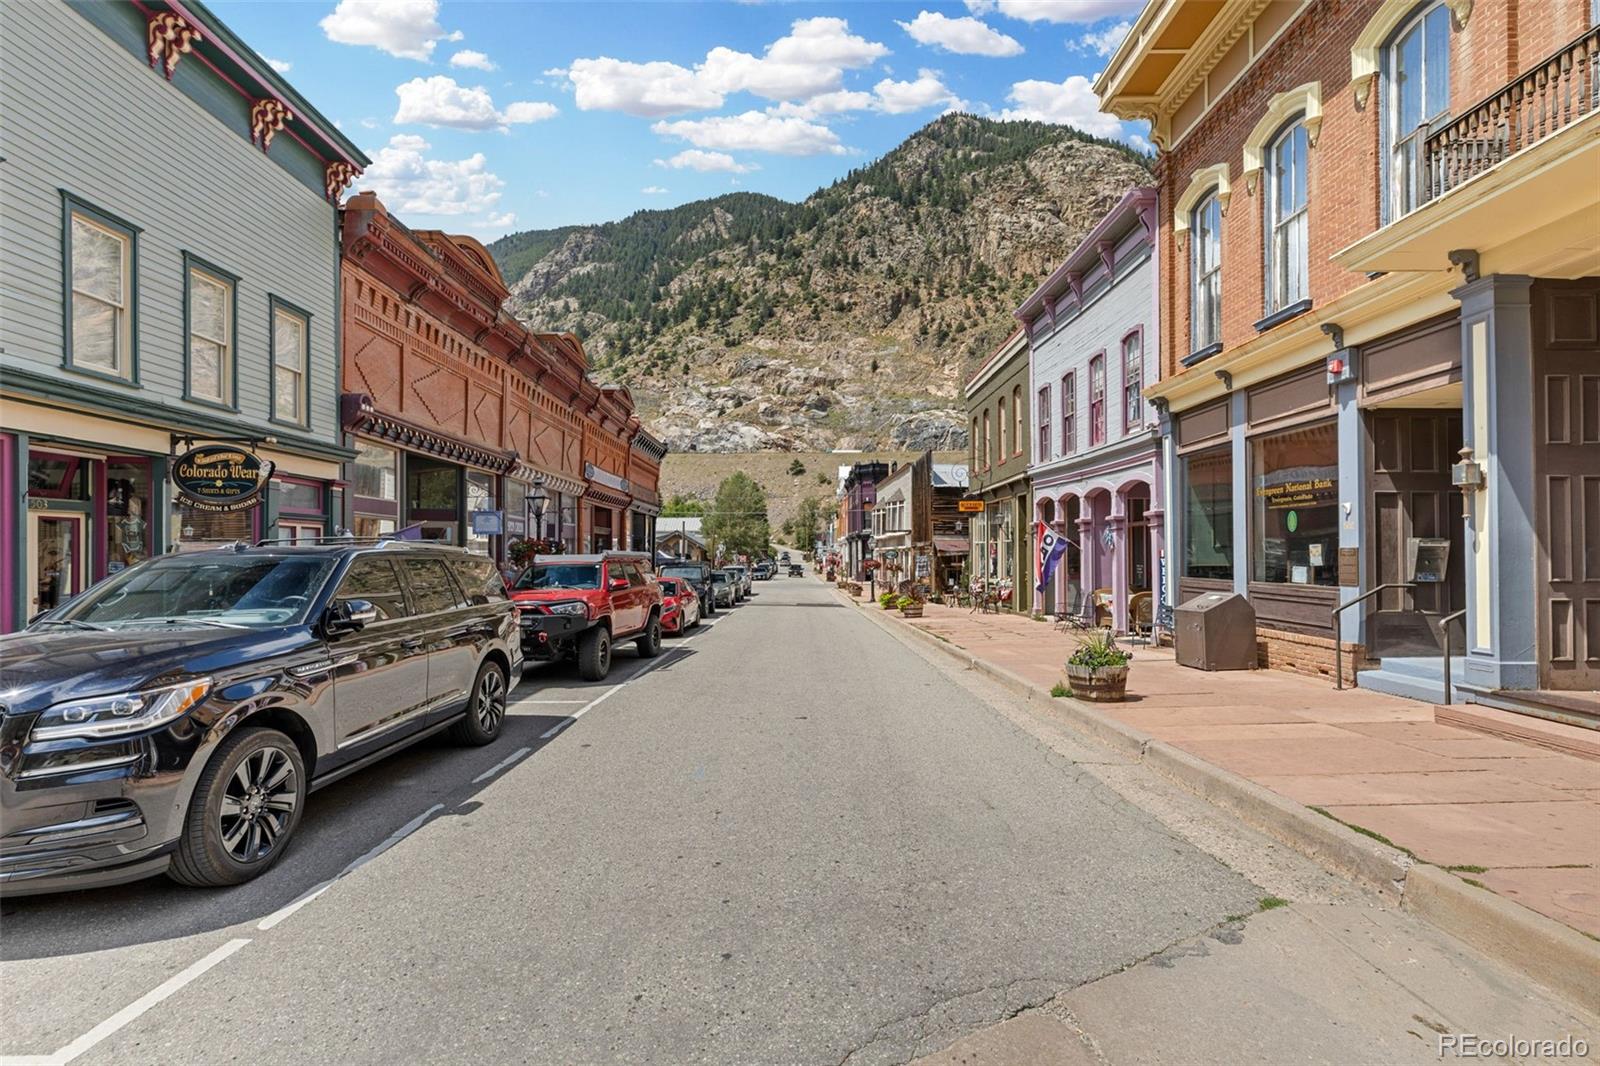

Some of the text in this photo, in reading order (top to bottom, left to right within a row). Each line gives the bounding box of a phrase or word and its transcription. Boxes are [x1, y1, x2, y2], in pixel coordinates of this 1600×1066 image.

[180, 463, 258, 479] Colorado Wear
[1285, 481, 1312, 493] National
[1314, 478, 1333, 489] Bank
[179, 496, 194, 507] ICE
[194, 502, 222, 512] CREAM
[230, 497, 257, 512] SODAS
